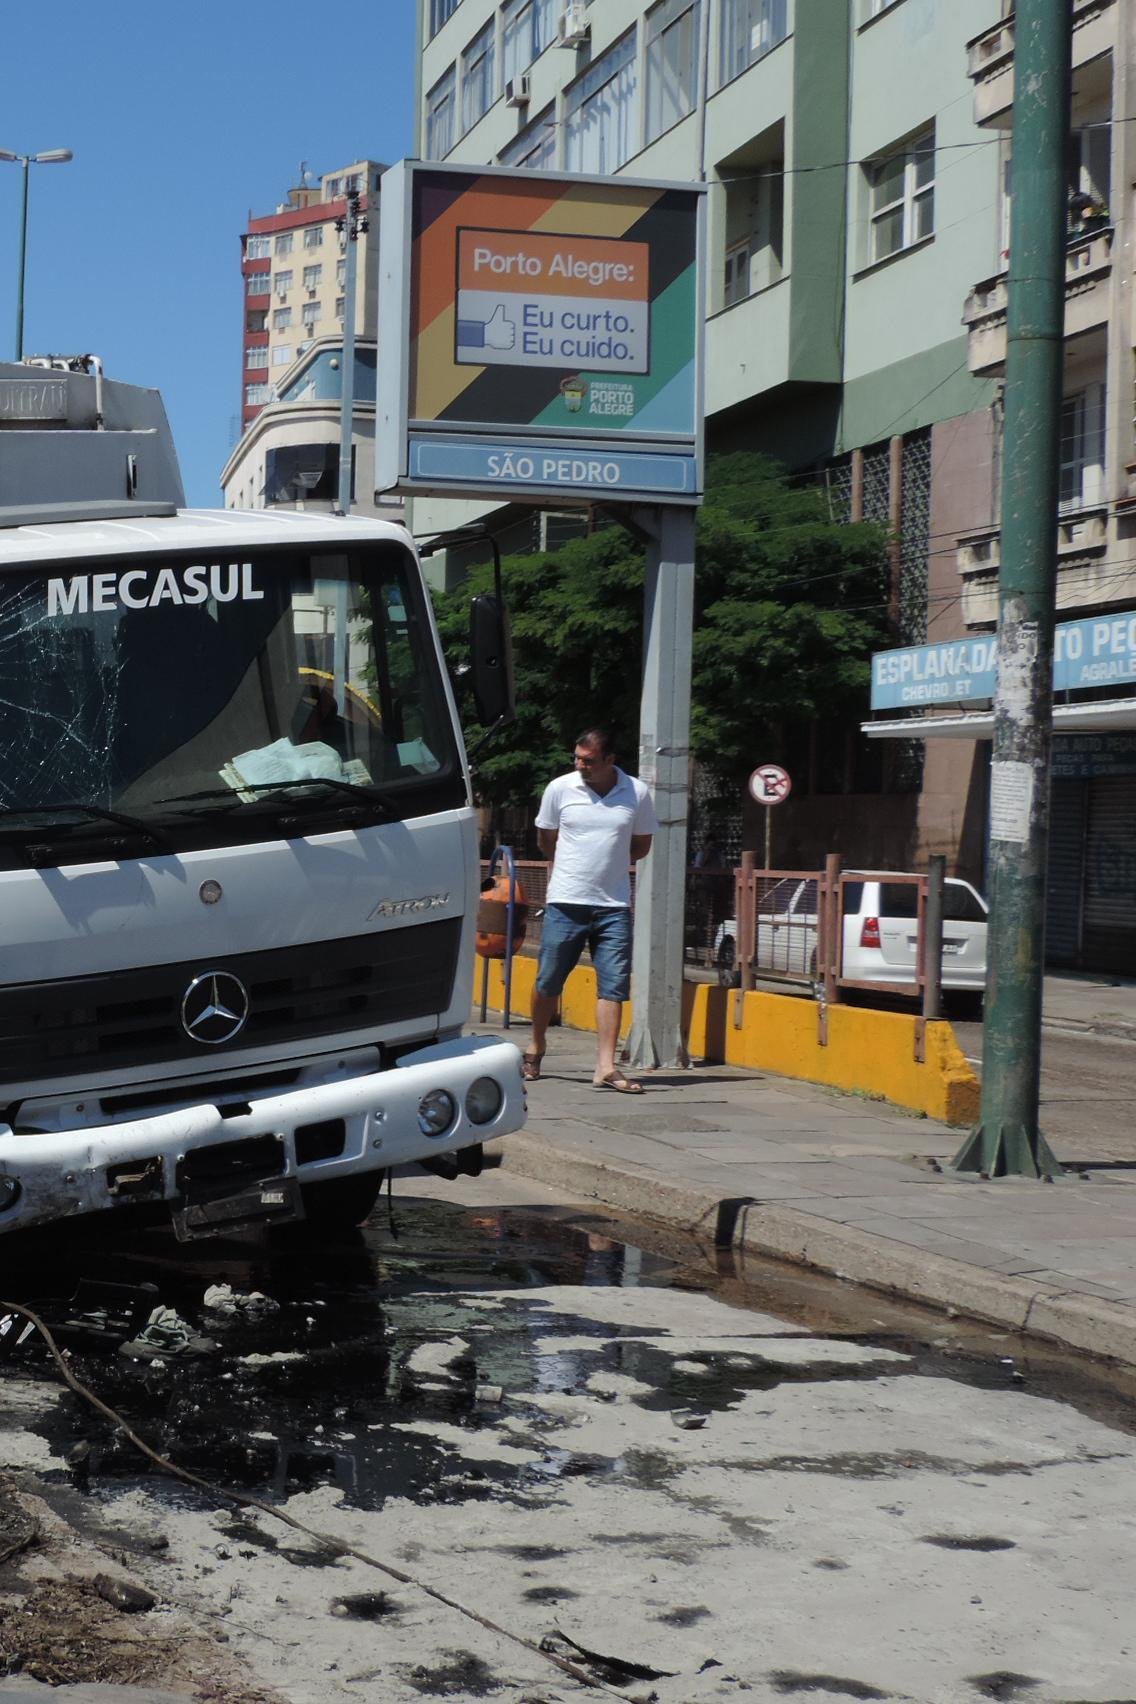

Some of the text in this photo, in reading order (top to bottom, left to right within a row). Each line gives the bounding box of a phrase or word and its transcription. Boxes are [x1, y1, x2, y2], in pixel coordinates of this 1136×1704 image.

[474, 248, 635, 286] Porto Alegre:
[522, 304, 635, 333] Eu curto.
[522, 332, 635, 360] Eu cuido.
[590, 382, 633, 391] PREFEITURA
[590, 390, 634, 404] PORTO
[589, 403, 634, 416] ALEGRE
[487, 452, 621, 484] SÃO PEDRO
[47, 563, 265, 617] MECASUL
[877, 640, 997, 686] ESPLANADA
[901, 679, 972, 701] CHEVROET
